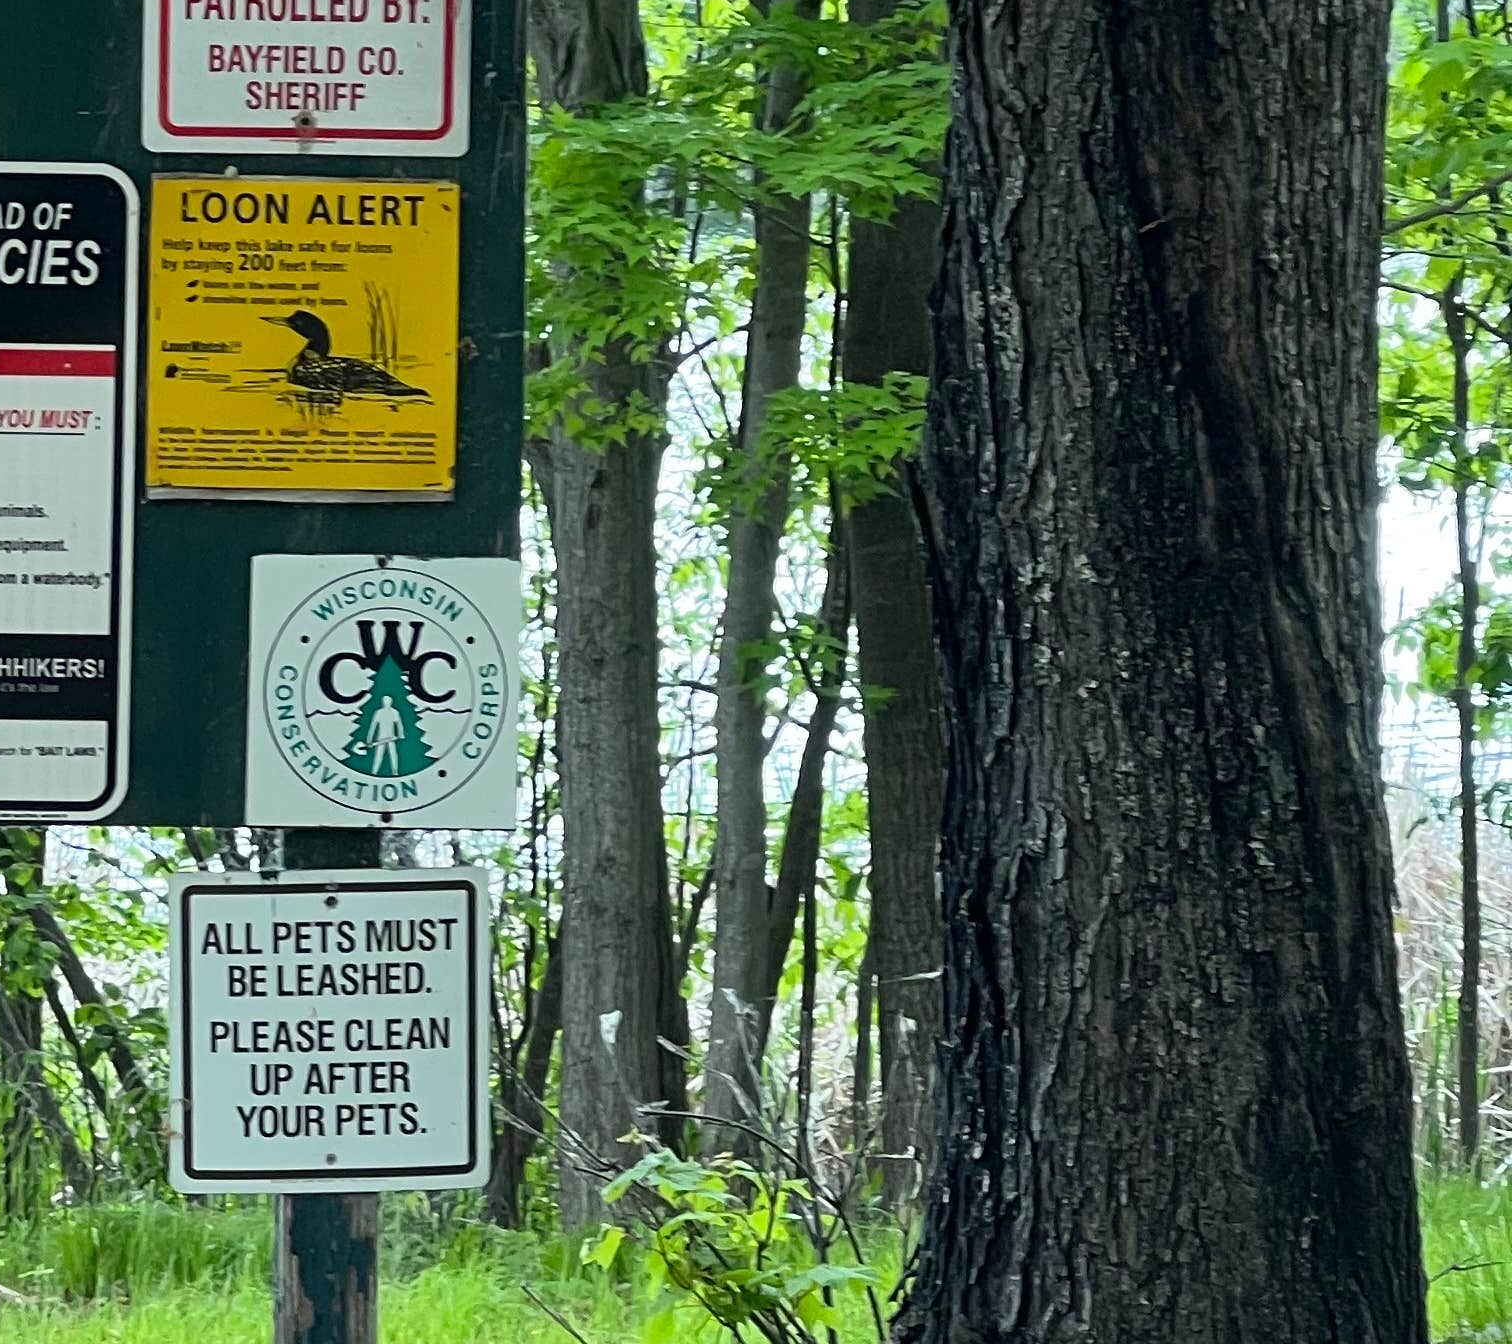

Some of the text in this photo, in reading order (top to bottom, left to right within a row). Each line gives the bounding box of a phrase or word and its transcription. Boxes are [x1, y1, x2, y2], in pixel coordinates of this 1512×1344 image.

[208, 44, 404, 76] BAYFIELD CO.
[245, 81, 367, 111] SHERIFF
[33, 203, 73, 231] OF
[181, 192, 424, 226] LOON ALERT
[238, 253, 274, 272] 200
[21, 573, 29, 584] a
[311, 579, 464, 622] WISCONSIN
[274, 663, 499, 802] CONSERVATION CORPS
[201, 918, 458, 955] ALL PETS MUST
[228, 962, 433, 998] BE LEASHED.
[210, 1017, 452, 1054] PLEASE CLEAN
[250, 1061, 411, 1096] UP AFTER
[237, 1102, 428, 1138] YOUR PETS.
